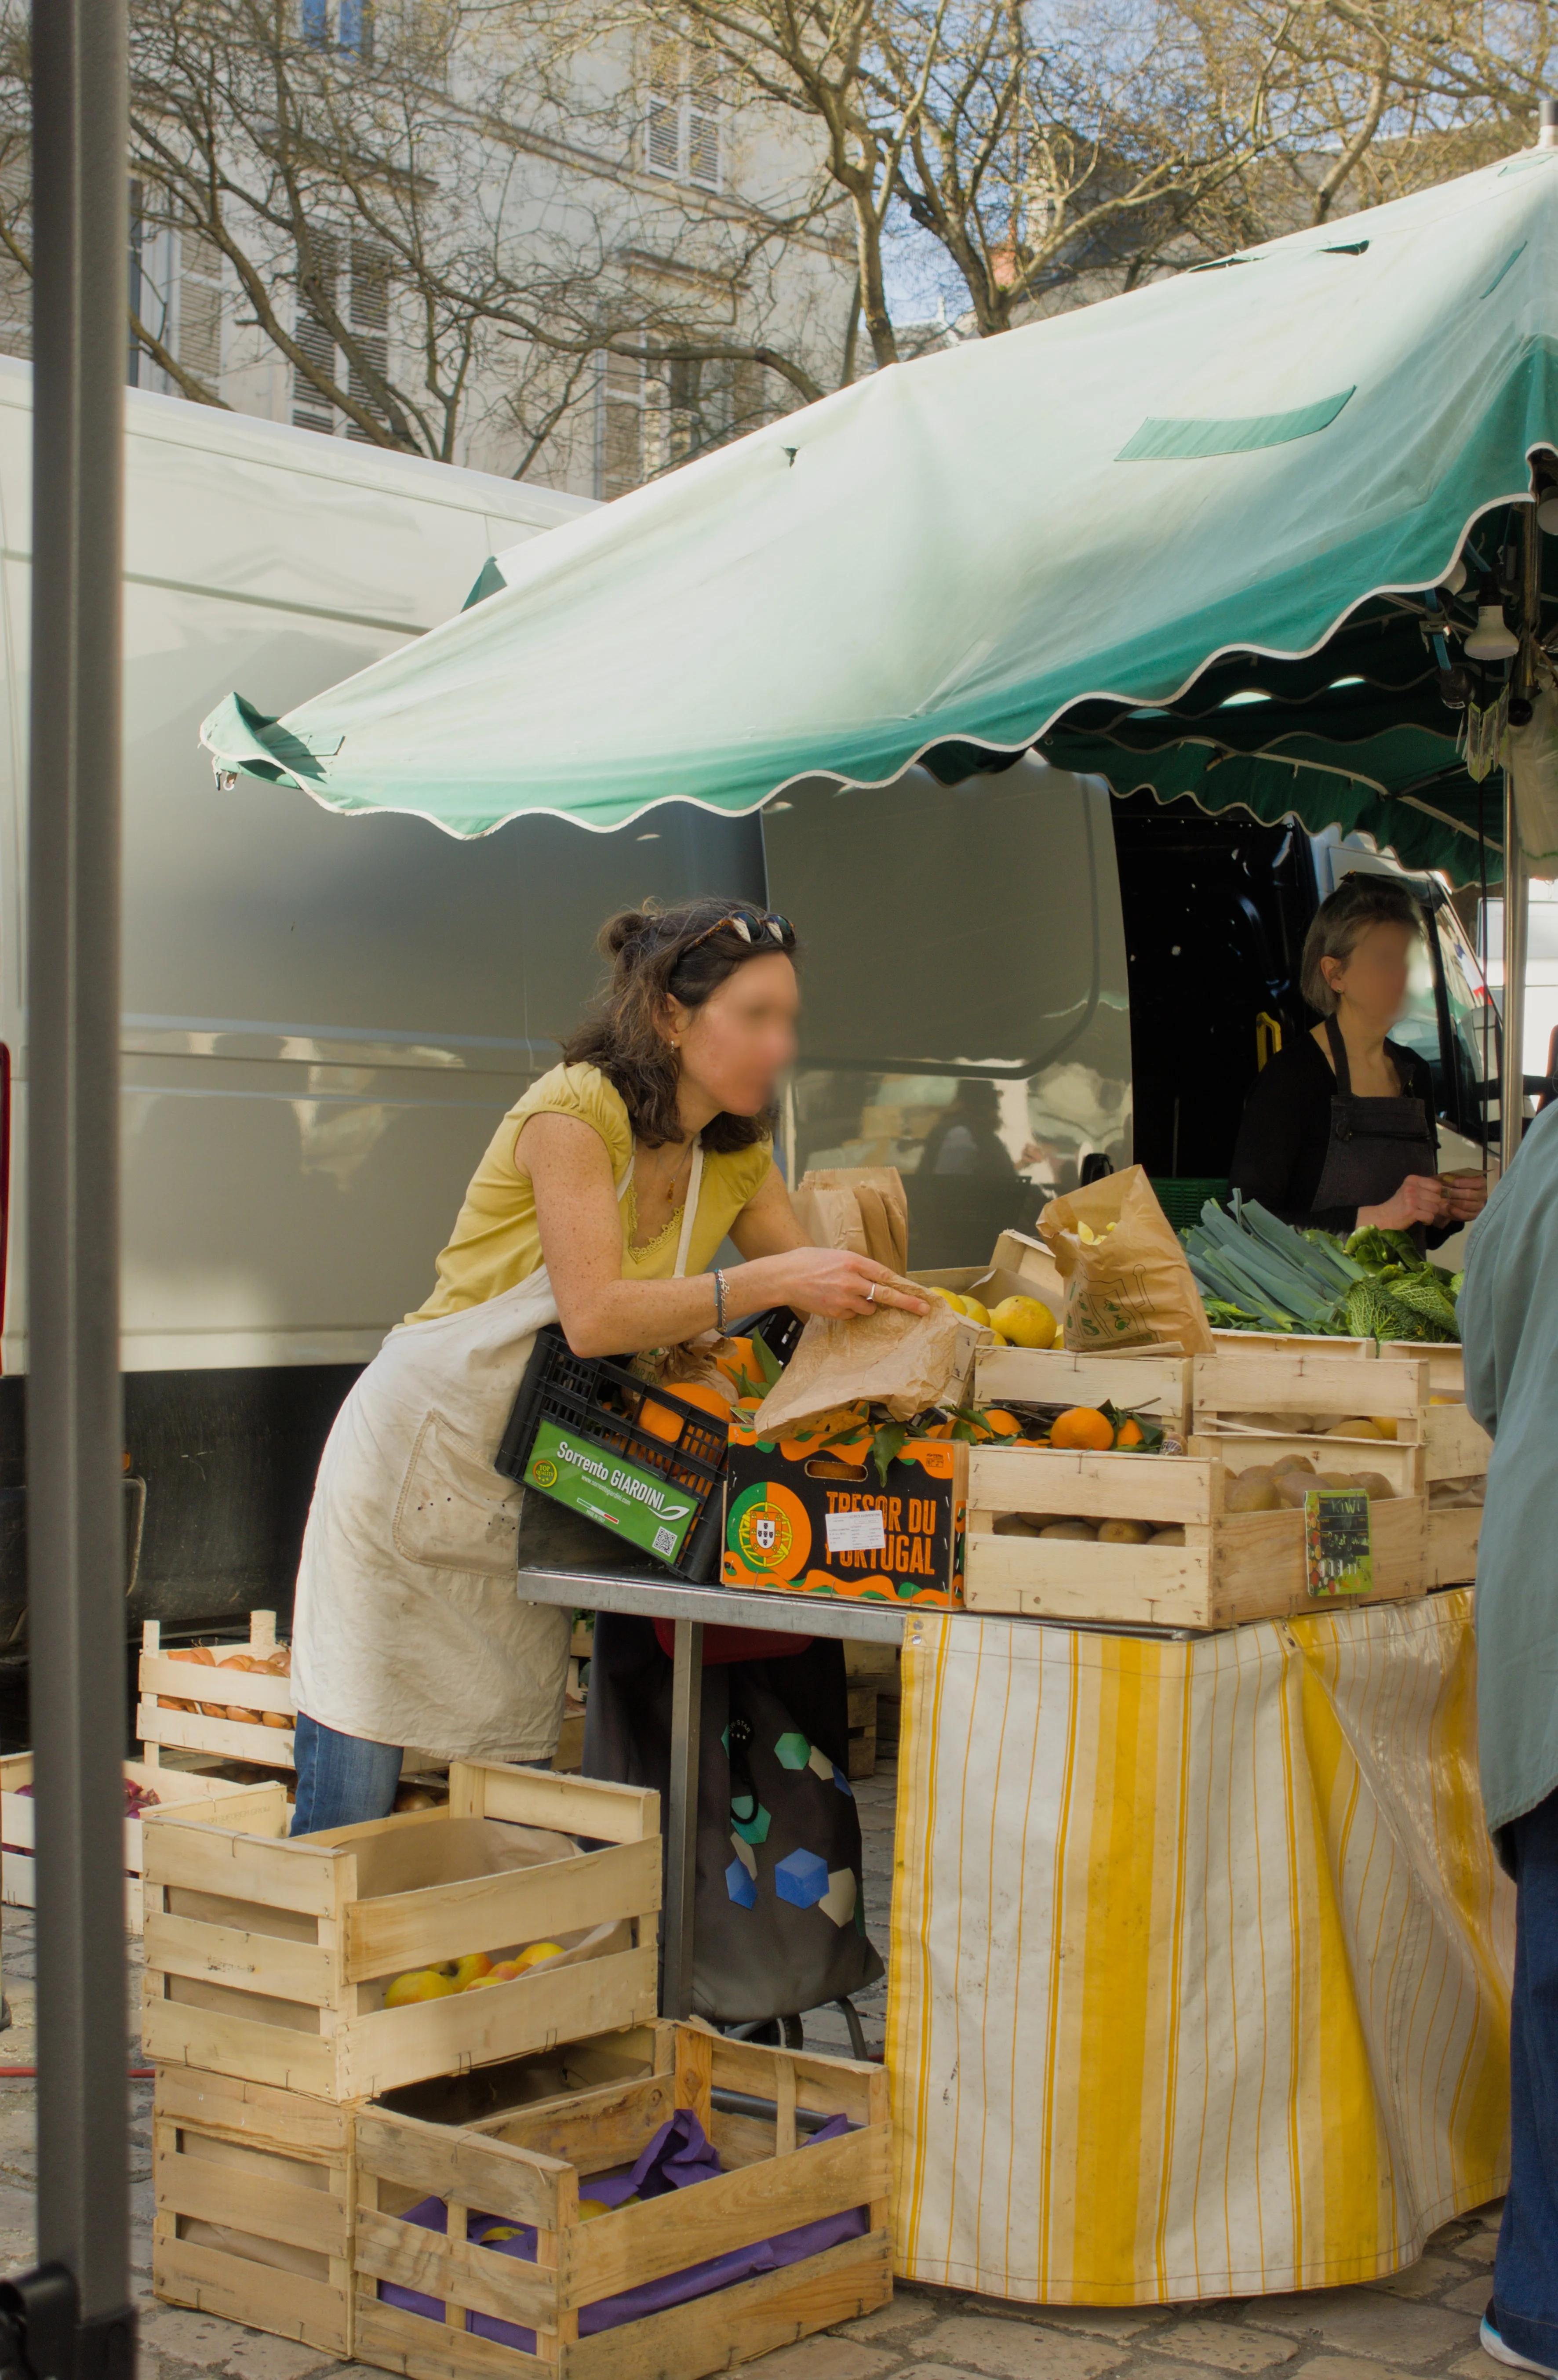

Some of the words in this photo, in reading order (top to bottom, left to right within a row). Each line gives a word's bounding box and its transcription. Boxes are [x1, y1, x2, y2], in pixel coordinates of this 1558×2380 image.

[557, 1441, 610, 1481] Sorrento
[610, 1469, 665, 1511] GIARDINI
[581, 1475, 631, 1506] www.sorrentogiardini.com
[908, 1498, 937, 1535] DU
